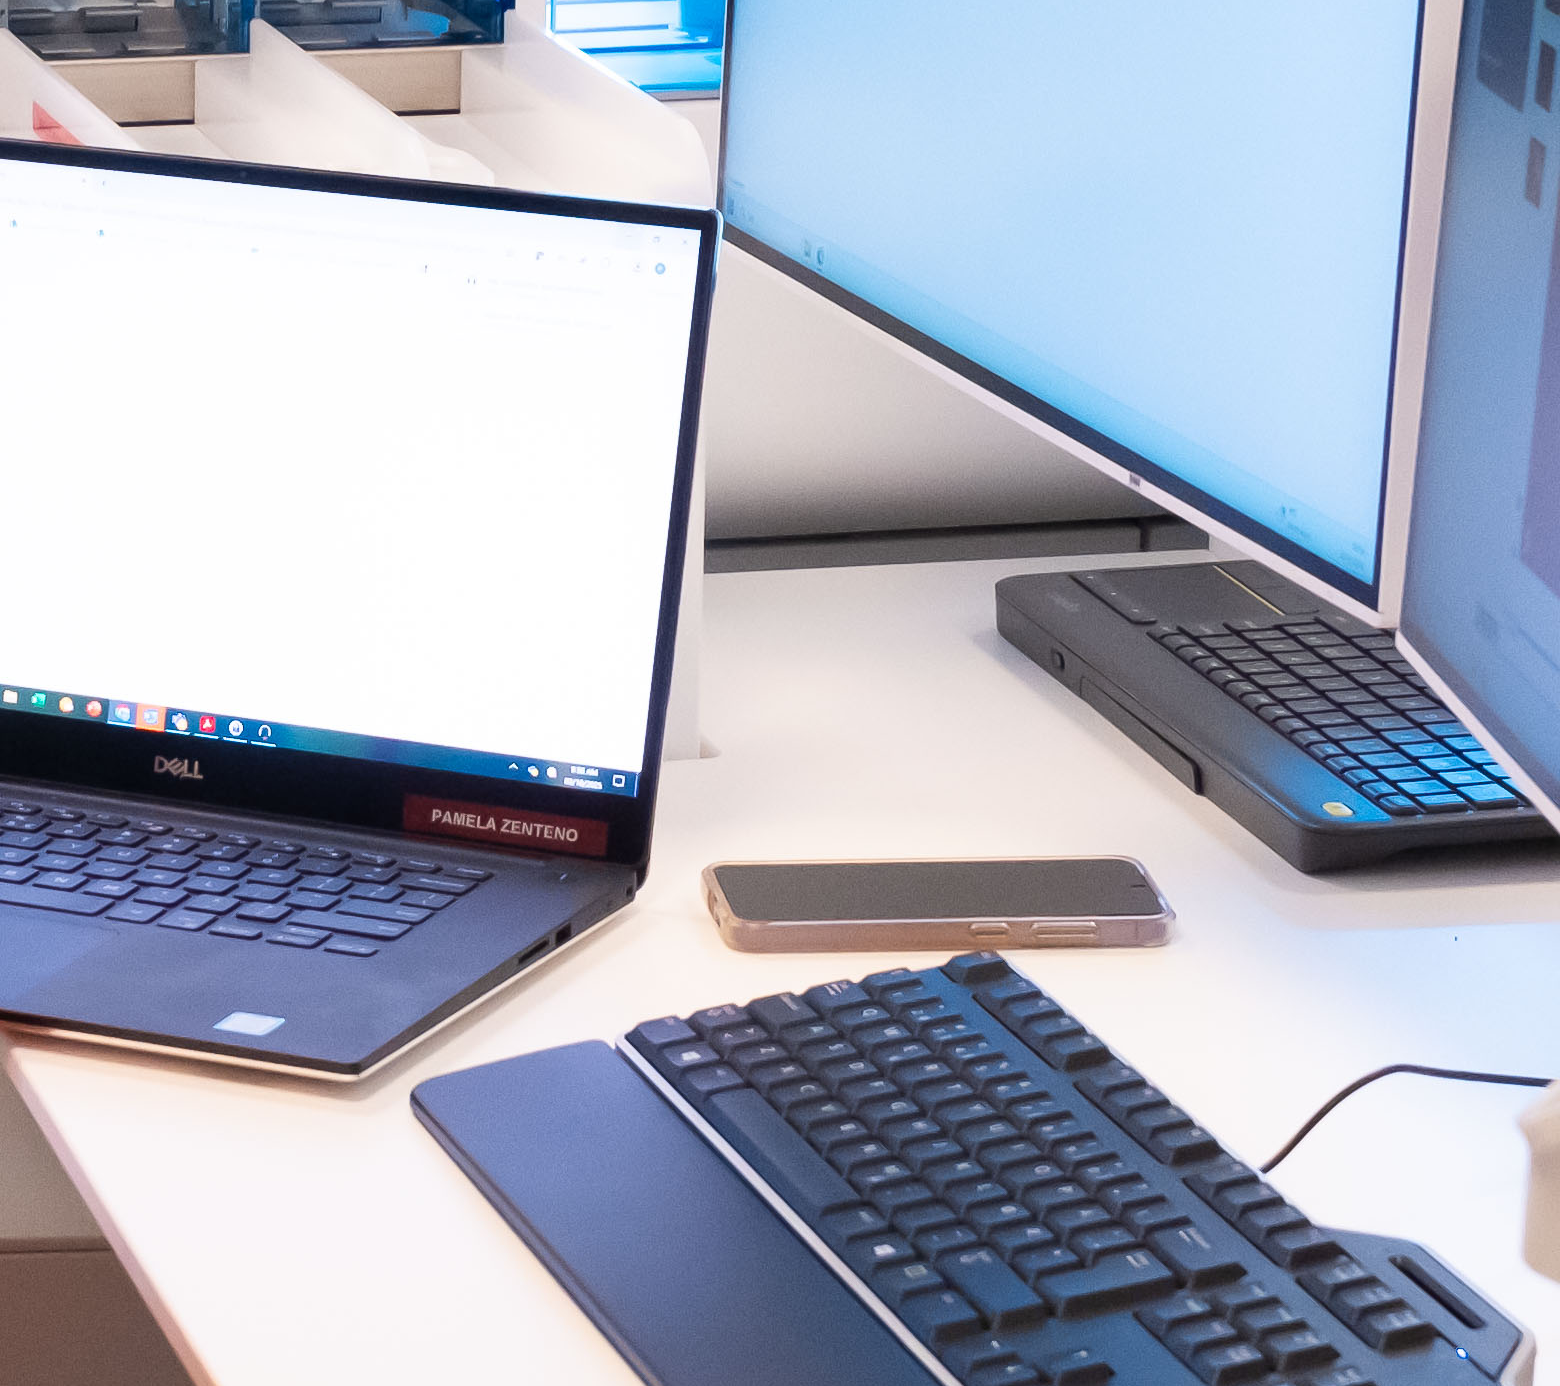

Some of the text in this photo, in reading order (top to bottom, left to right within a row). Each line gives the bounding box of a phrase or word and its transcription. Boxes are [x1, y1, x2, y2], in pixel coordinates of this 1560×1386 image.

[154, 755, 204, 780] DELL
[431, 808, 579, 843] PAMELA ZENTENO
